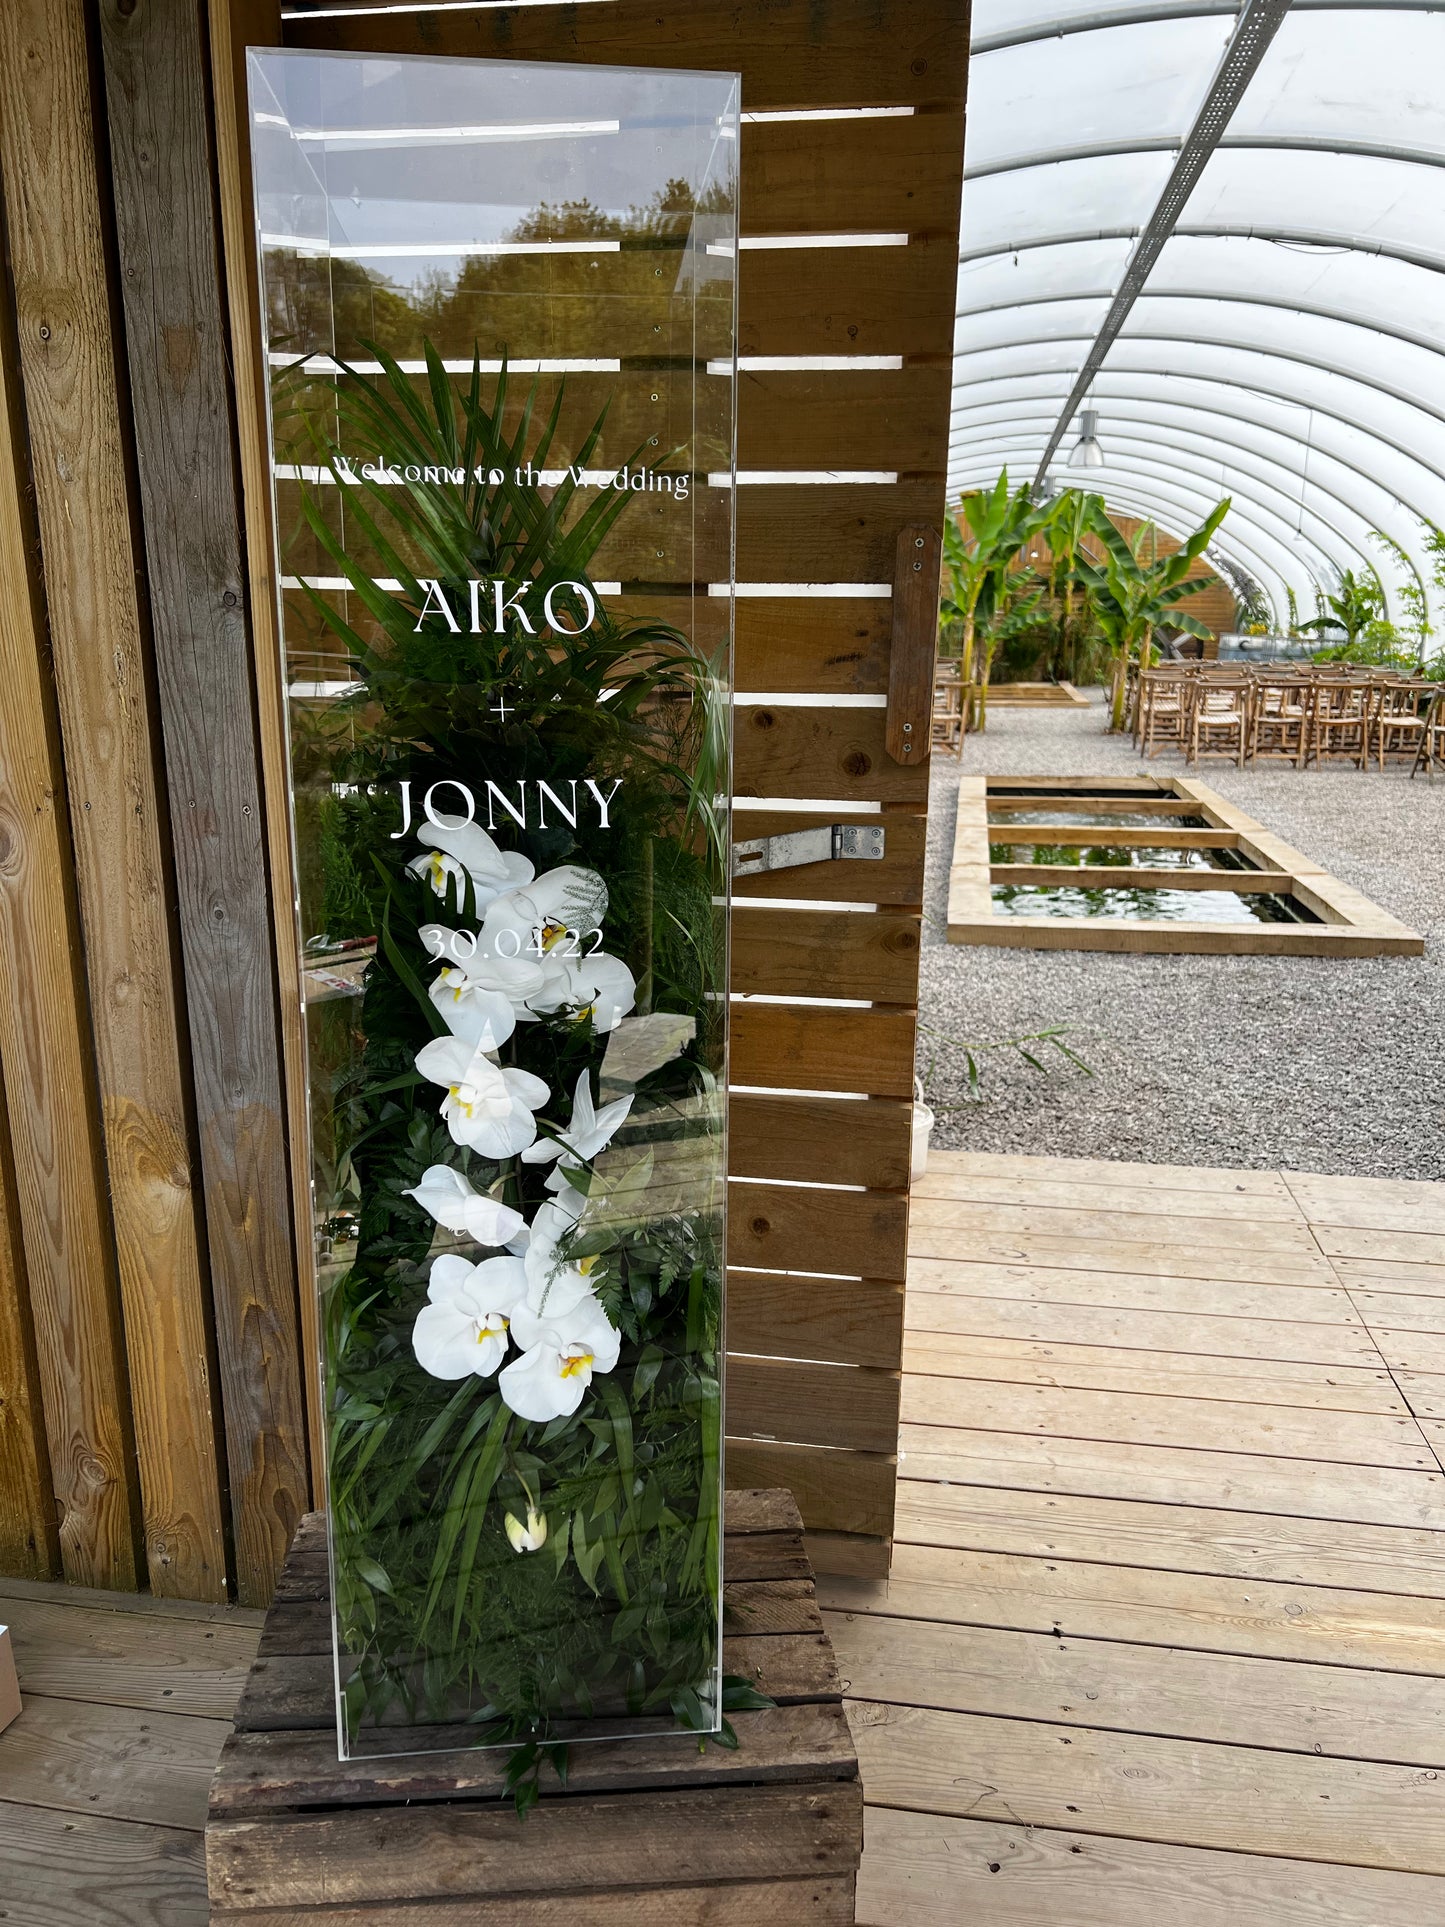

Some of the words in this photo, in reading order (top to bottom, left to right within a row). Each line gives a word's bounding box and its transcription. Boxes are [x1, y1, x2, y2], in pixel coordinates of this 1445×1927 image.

[332, 455, 466, 484] Welcome
[477, 466, 505, 486] to
[514, 461, 559, 488] the
[568, 464, 690, 500] Wedding
[412, 579, 596, 635] AIKO
[489, 697, 515, 723] +
[390, 779, 624, 839] JONNY
[427, 928, 605, 965] 30.04.22
